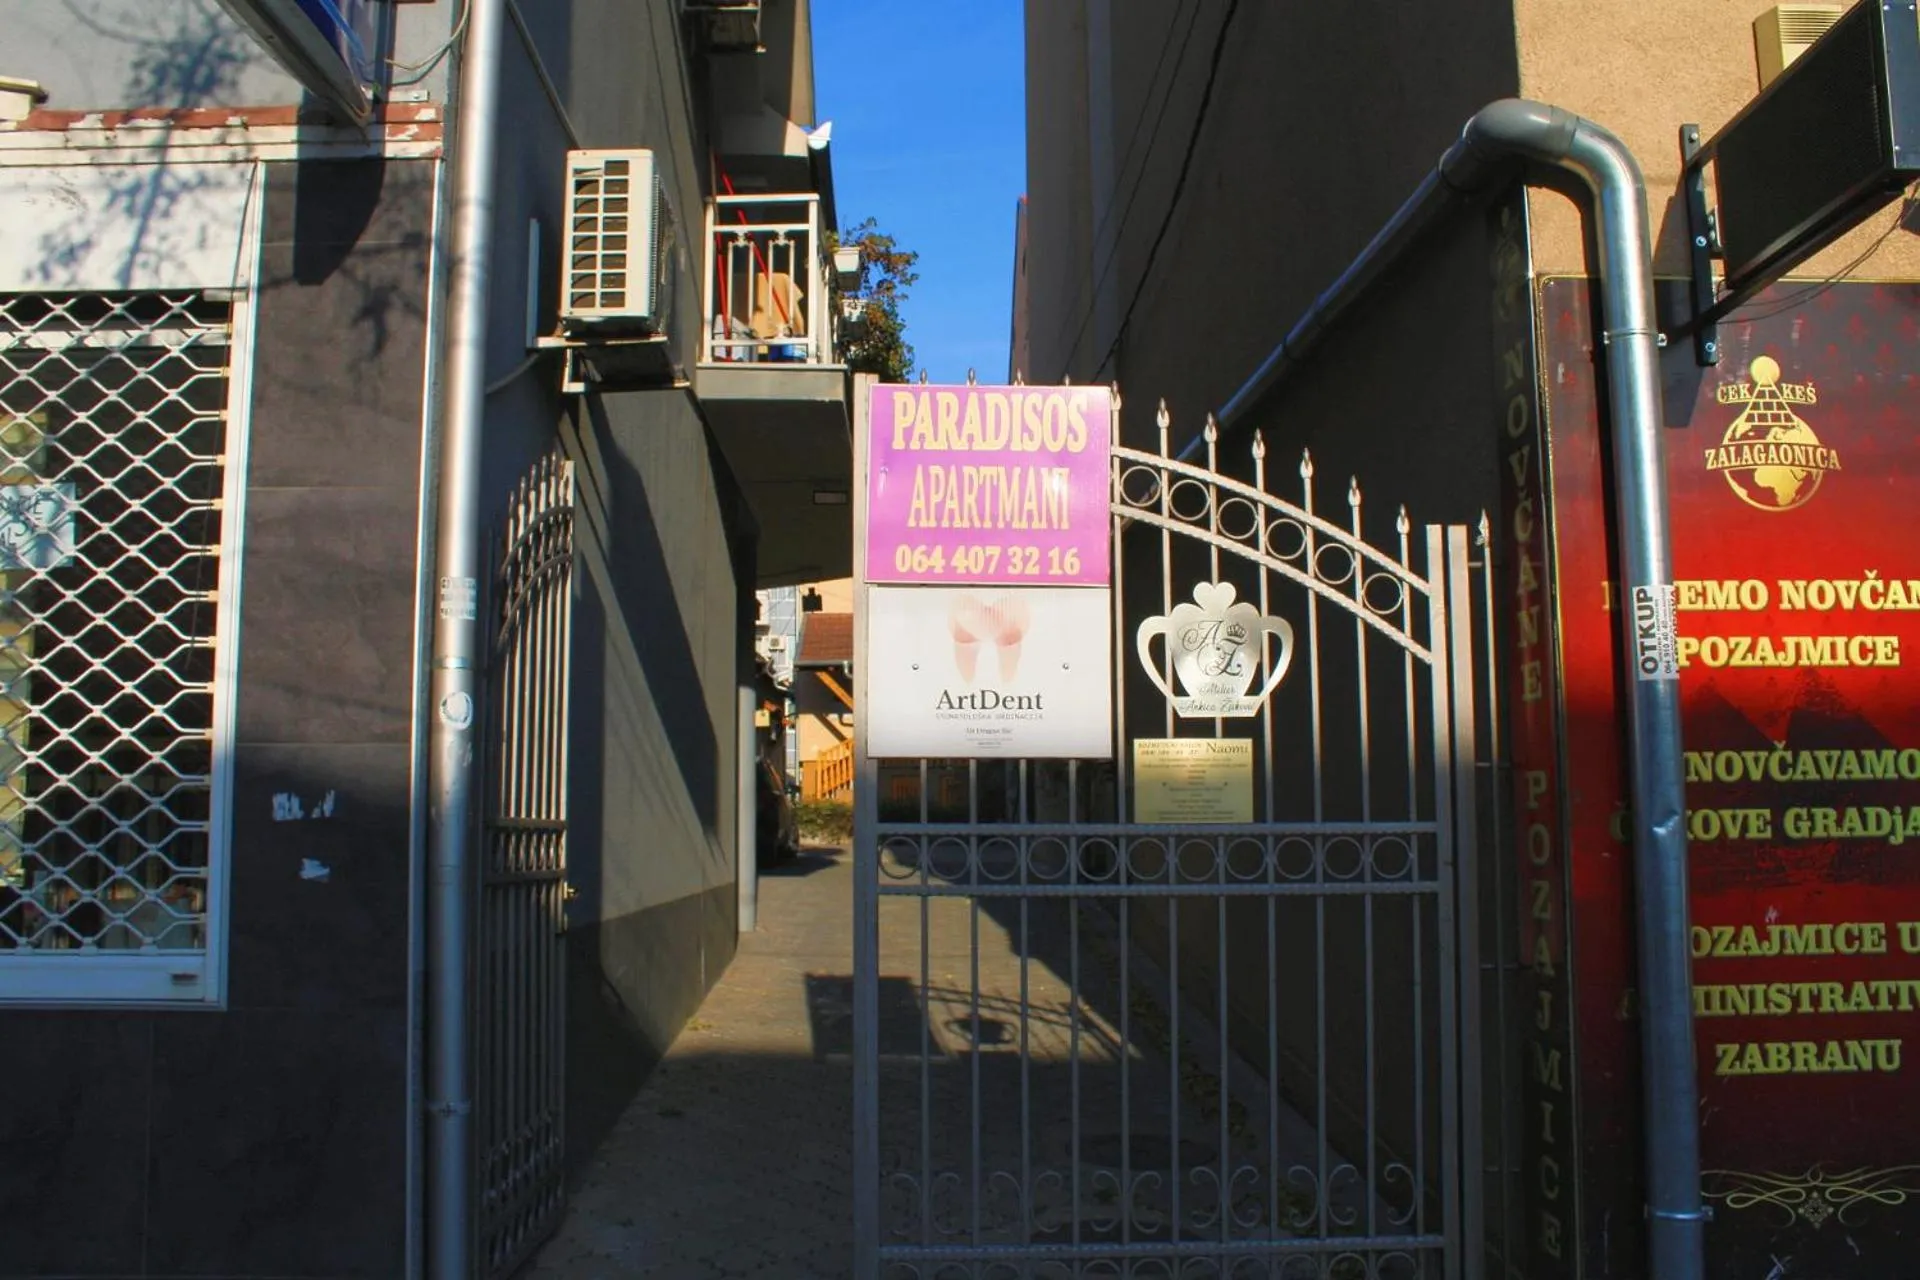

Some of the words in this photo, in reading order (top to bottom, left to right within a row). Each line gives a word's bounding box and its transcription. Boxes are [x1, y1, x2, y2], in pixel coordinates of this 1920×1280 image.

[1781, 381, 1817, 404] KEŠ
[891, 390, 1088, 453] PARADISOS
[1704, 443, 1842, 471] ZALAGAONICA
[907, 464, 1070, 530] APARTMANI
[895, 543, 946, 574] 064
[950, 544, 1002, 575] 407
[1007, 545, 1041, 575] 32
[1048, 545, 1081, 576] 16
[1636, 587, 1659, 675] OTKUP
[1676, 635, 1900, 667] POZAJMICE
[935, 688, 1044, 710] ArtDent
[1684, 740, 1920, 782] NOVČAVAMO
[1692, 922, 1887, 958] OZAJMICE
[1716, 1039, 1902, 1076] ZABRANU
